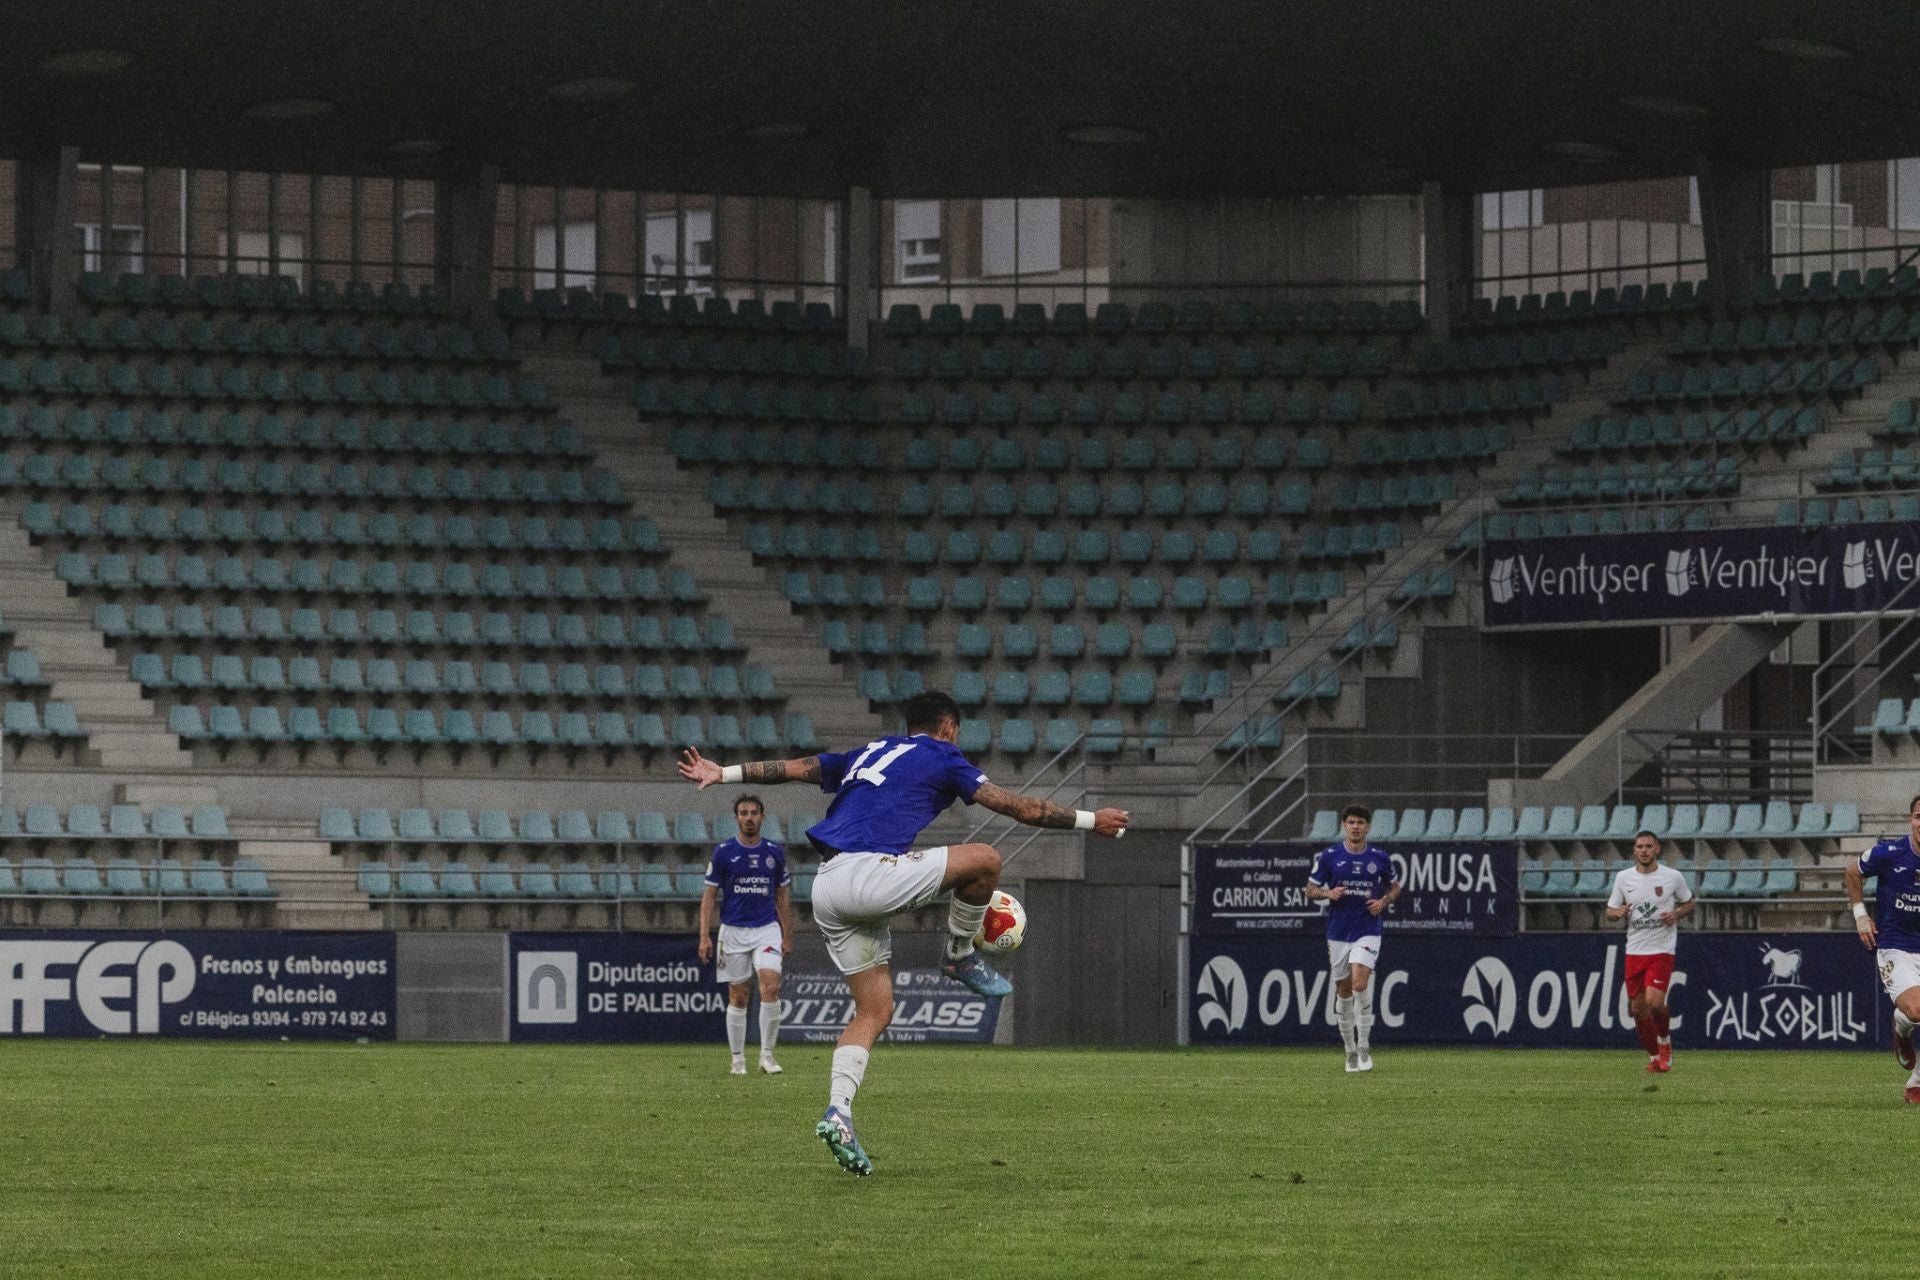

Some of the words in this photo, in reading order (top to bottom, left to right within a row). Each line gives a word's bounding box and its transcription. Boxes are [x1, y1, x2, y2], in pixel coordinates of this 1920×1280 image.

[1874, 537, 1920, 582] Ve
[1518, 552, 1655, 604] Ventyser
[1215, 858, 1266, 868] Mantenimiento
[1267, 860, 1273, 870] y
[1389, 853, 1497, 892] OMUSA
[1242, 872, 1252, 882] de
[1253, 872, 1283, 882] Calderas
[1213, 887, 1279, 907] CARRION
[1343, 887, 1372, 897] anisa
[201, 954, 263, 975] Frenos
[268, 958, 280, 980] y
[284, 954, 388, 980] Embragues
[587, 961, 700, 987] Diputación
[252, 984, 338, 1004] Palencia
[796, 982, 850, 995] OTER
[587, 993, 618, 1013] DE
[623, 993, 726, 1013] PALENCIA
[180, 1011, 193, 1026] c/
[197, 1011, 249, 1029] Bélgica
[253, 1011, 290, 1026] 93/94
[302, 1011, 326, 1026] 979
[330, 1011, 347, 1026] 74
[350, 1011, 367, 1026] 92
[370, 1011, 387, 1026] 43
[1706, 989, 1867, 1042] PALEOBULL
